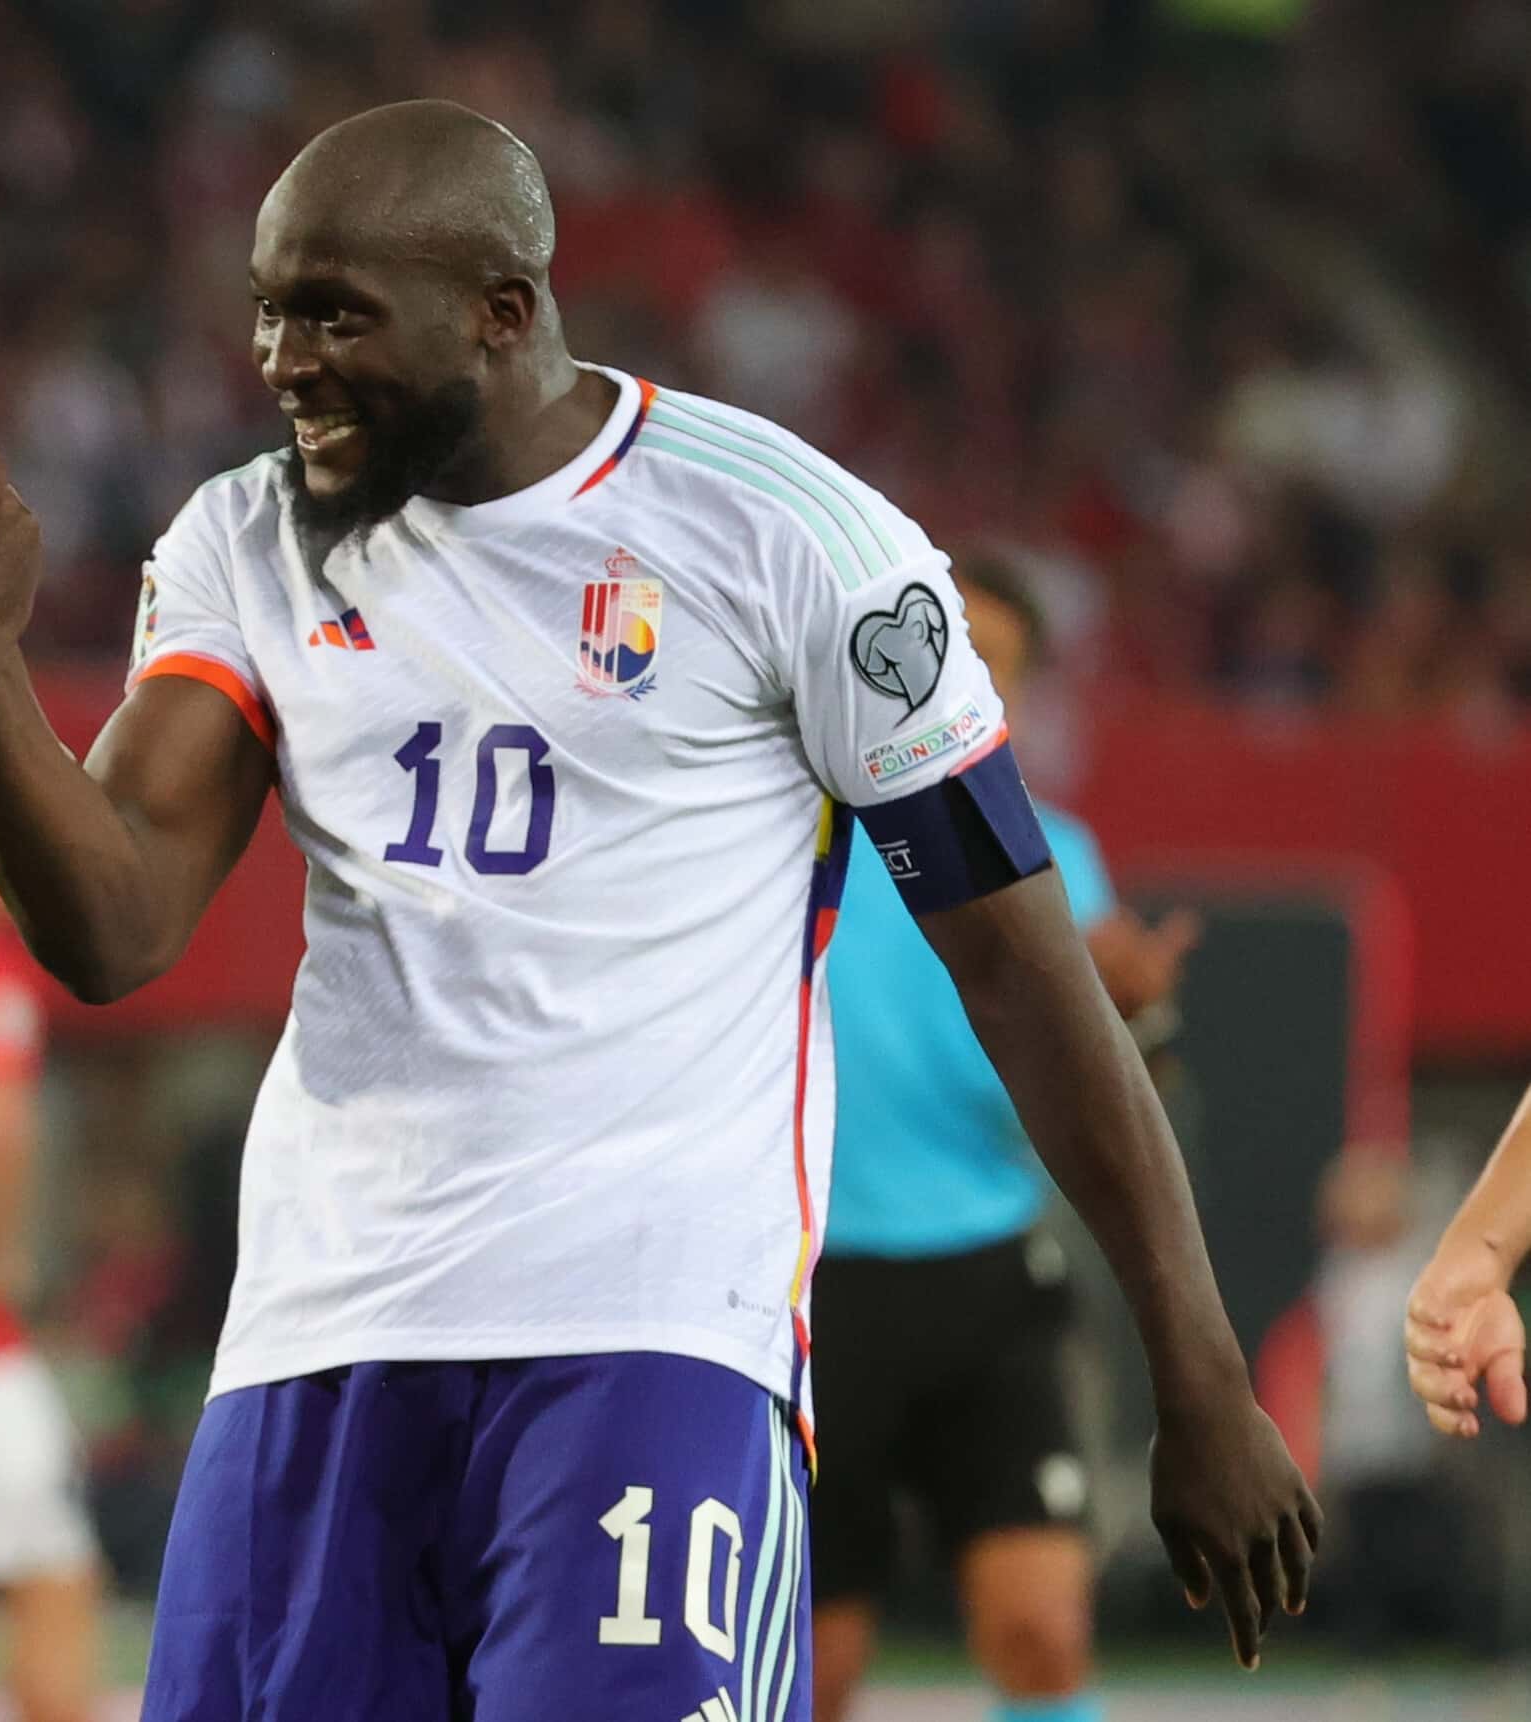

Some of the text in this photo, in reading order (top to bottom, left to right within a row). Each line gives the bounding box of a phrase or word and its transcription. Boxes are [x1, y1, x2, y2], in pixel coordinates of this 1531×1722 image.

[383, 721, 555, 875] 10
[869, 706, 981, 778] FOUNDATION
[598, 1485, 744, 1663] 10
